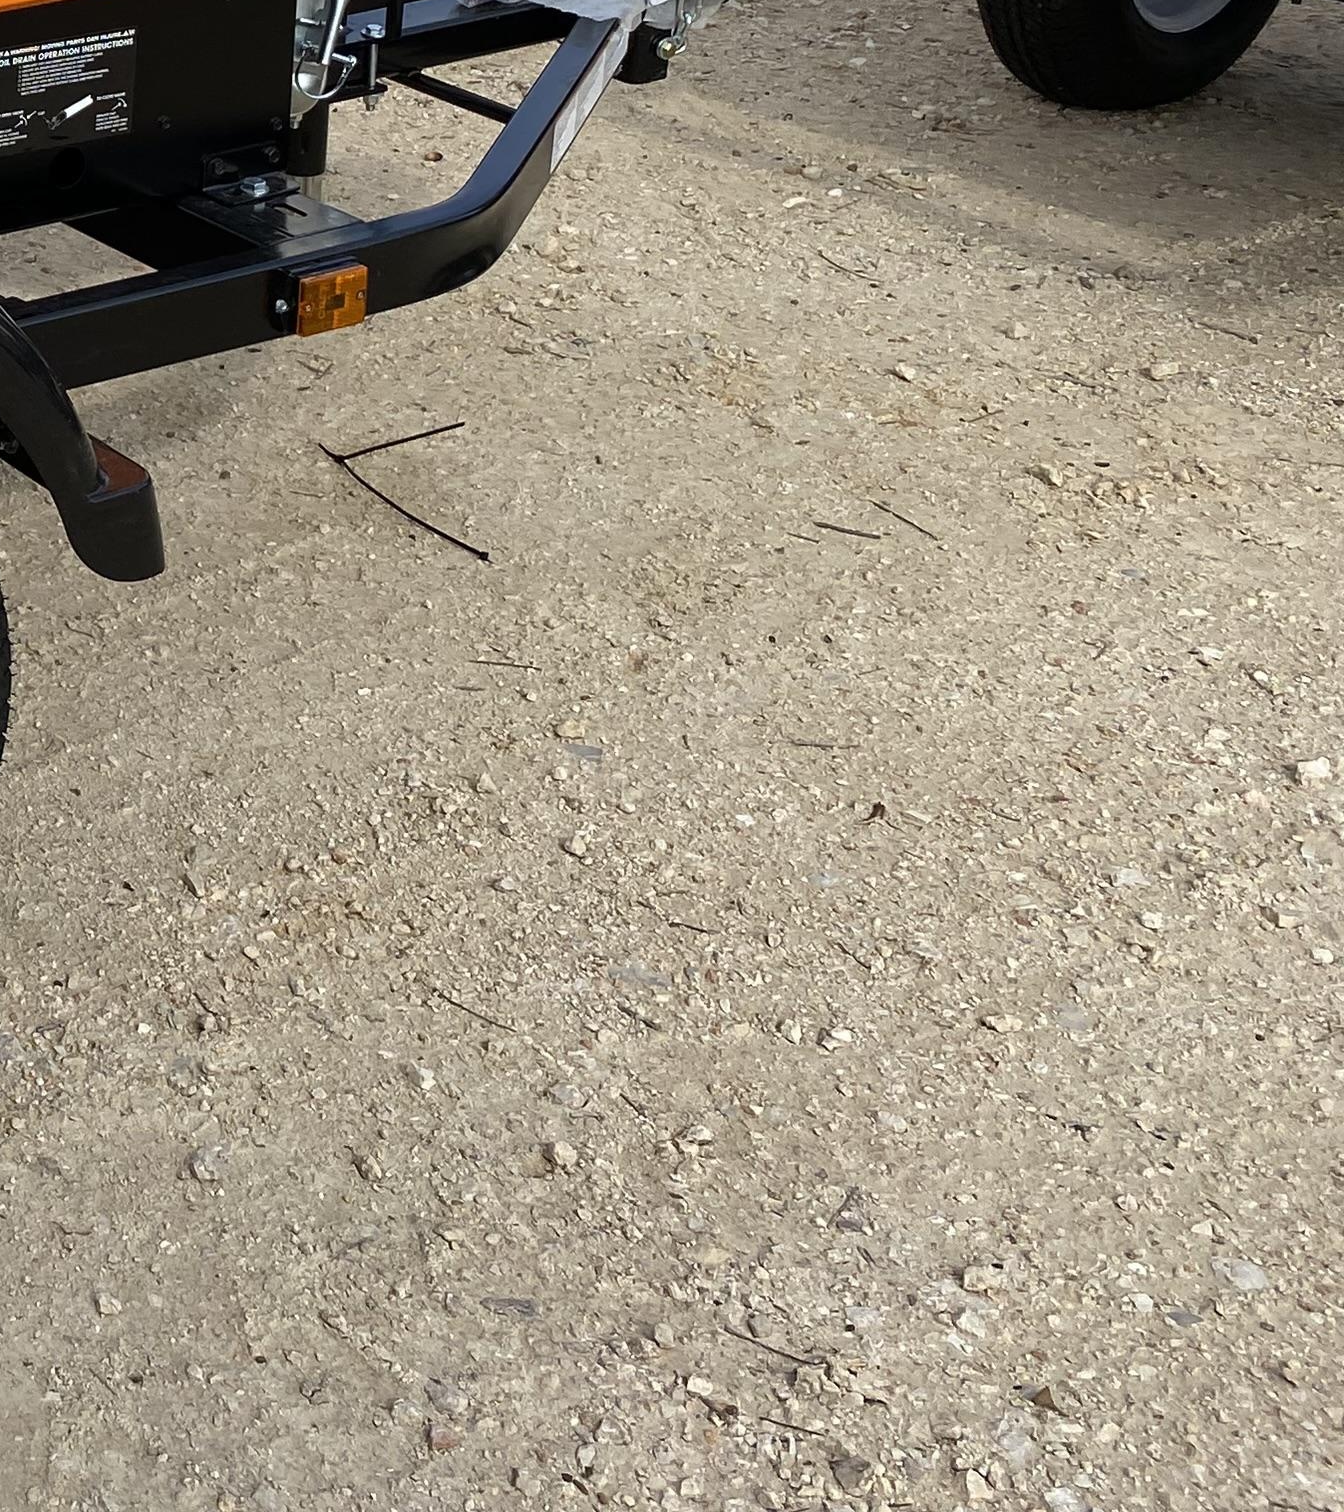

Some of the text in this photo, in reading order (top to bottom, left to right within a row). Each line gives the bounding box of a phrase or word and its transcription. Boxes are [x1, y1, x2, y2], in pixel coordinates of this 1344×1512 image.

[12, 53, 37, 65] DRAIN
[37, 48, 80, 61] OPERATION
[81, 37, 134, 53] INSTRUCTIONS
